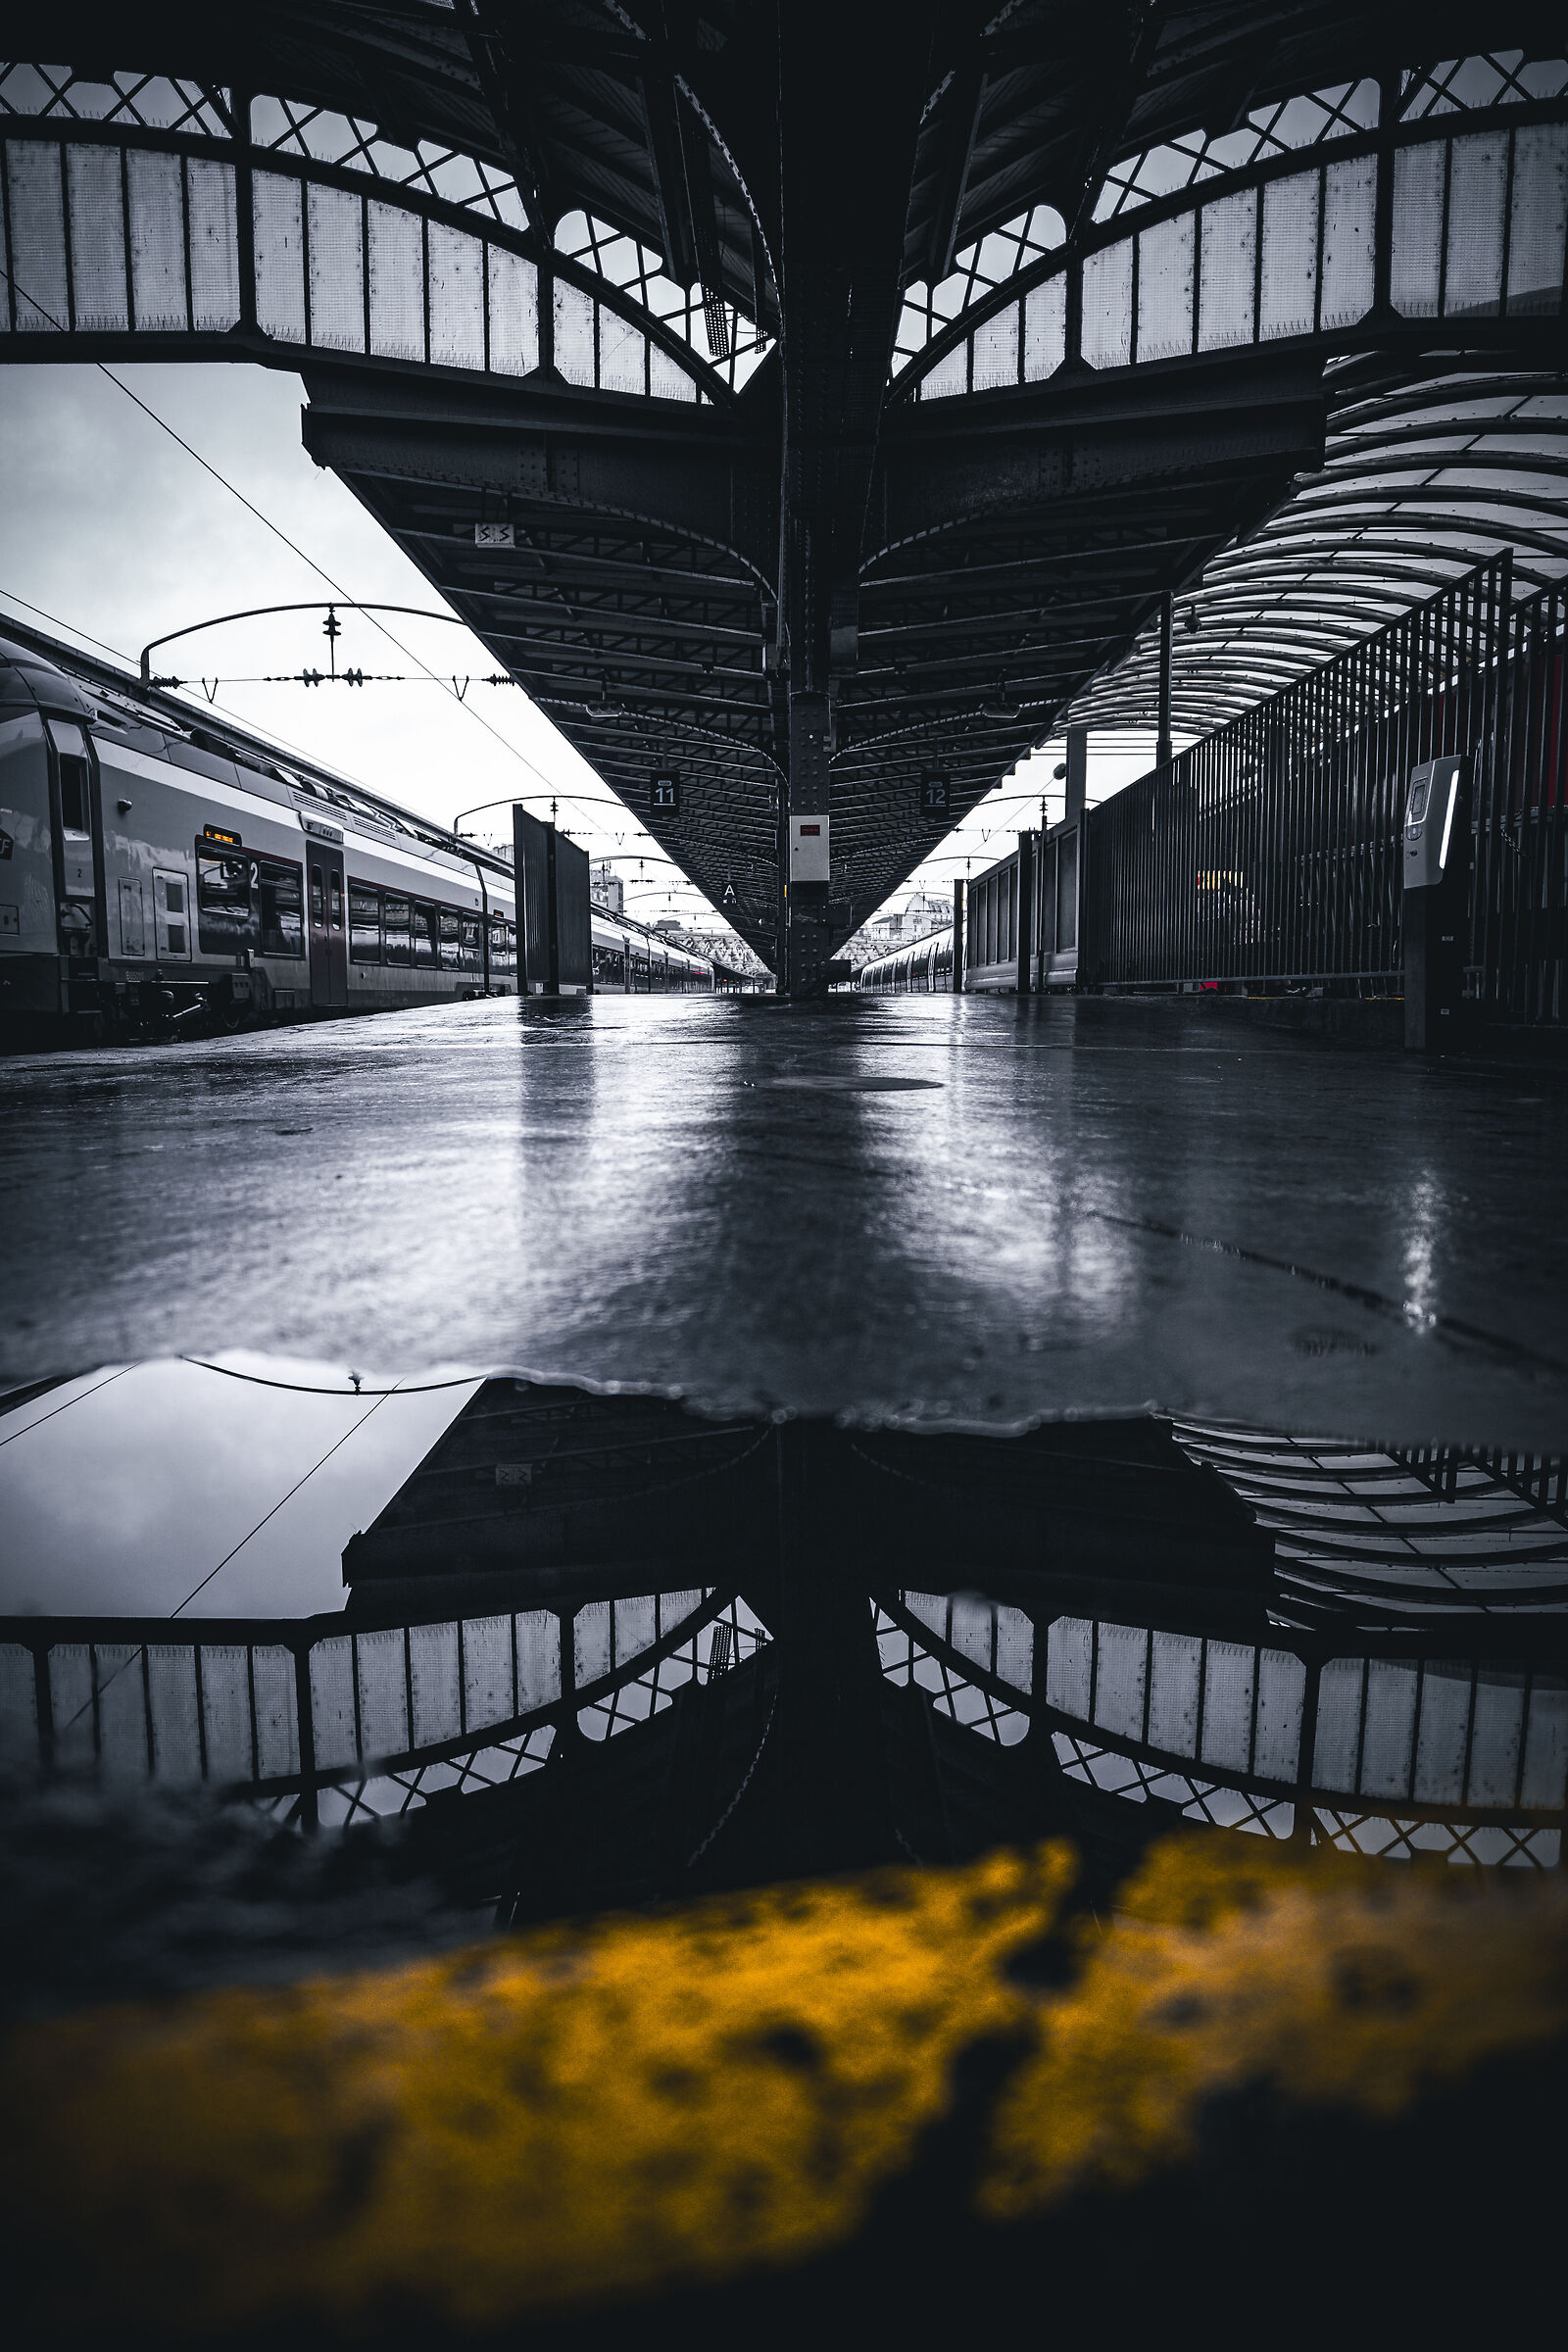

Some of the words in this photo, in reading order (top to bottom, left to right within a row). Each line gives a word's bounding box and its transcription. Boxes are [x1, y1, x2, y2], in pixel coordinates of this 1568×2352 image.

[655, 787, 674, 803] 11
[925, 788, 946, 805] 12
[77, 868, 82, 878] 2
[250, 861, 259, 890] 2
[724, 884, 735, 896] A
